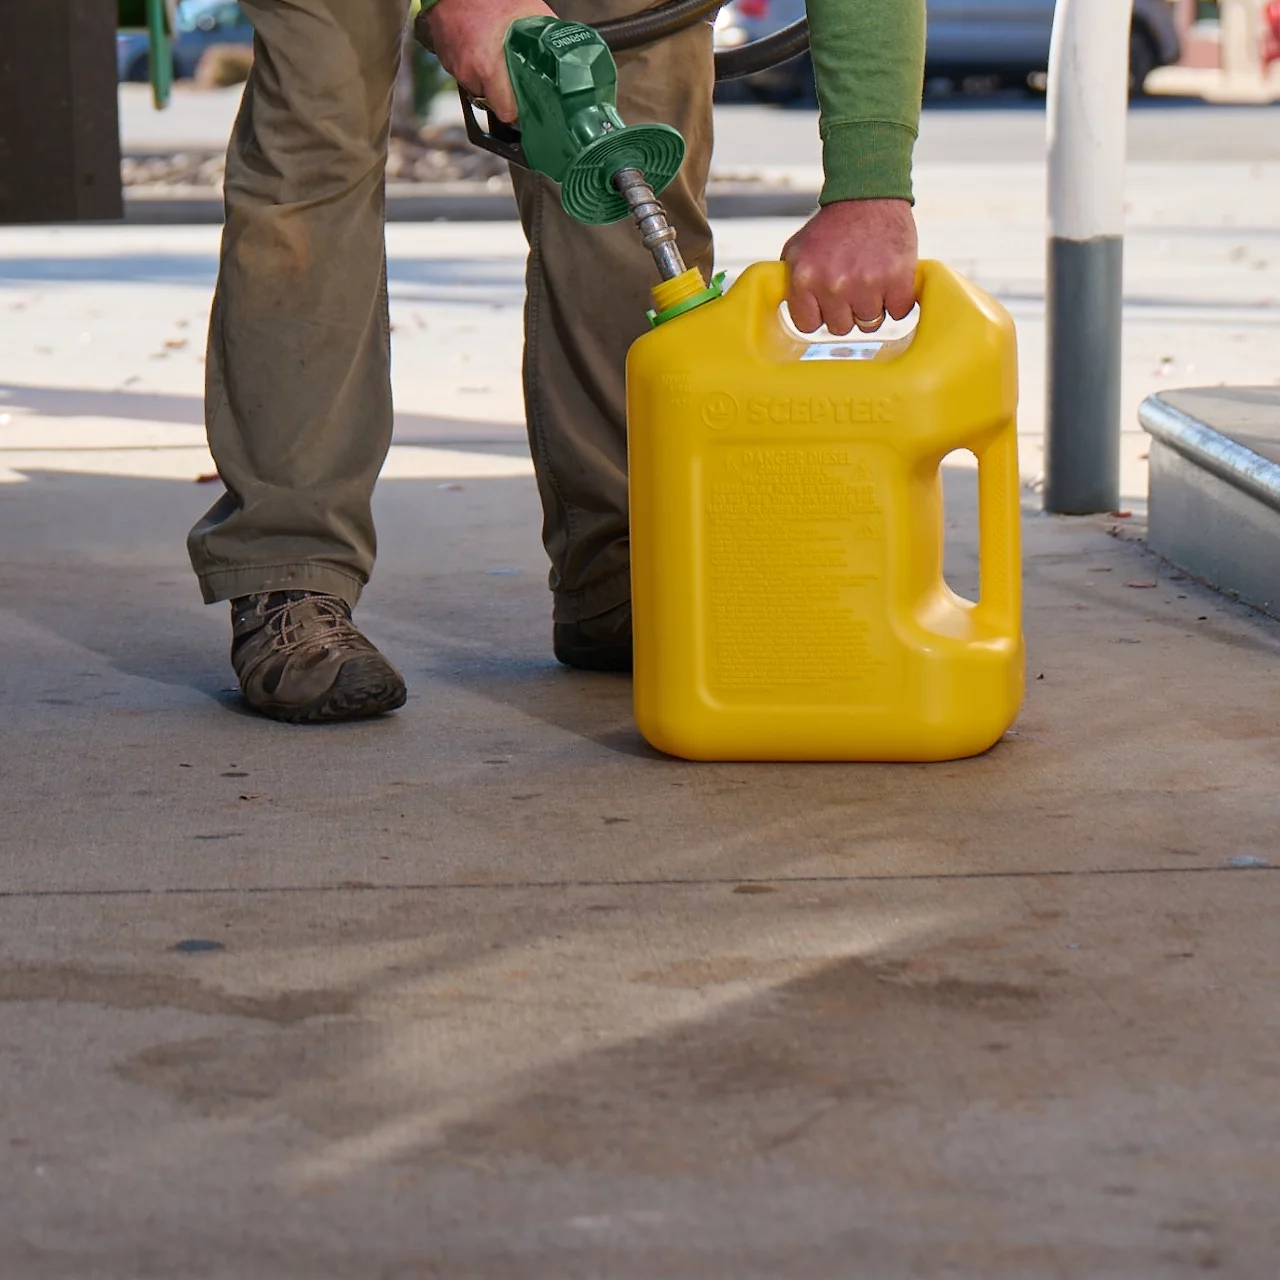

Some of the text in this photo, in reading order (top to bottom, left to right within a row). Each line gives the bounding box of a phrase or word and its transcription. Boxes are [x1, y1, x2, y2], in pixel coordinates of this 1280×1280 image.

[552, 31, 591, 48] WARNING
[747, 397, 892, 424] SCEPTER
[743, 451, 852, 466] DANGER DIESEL
